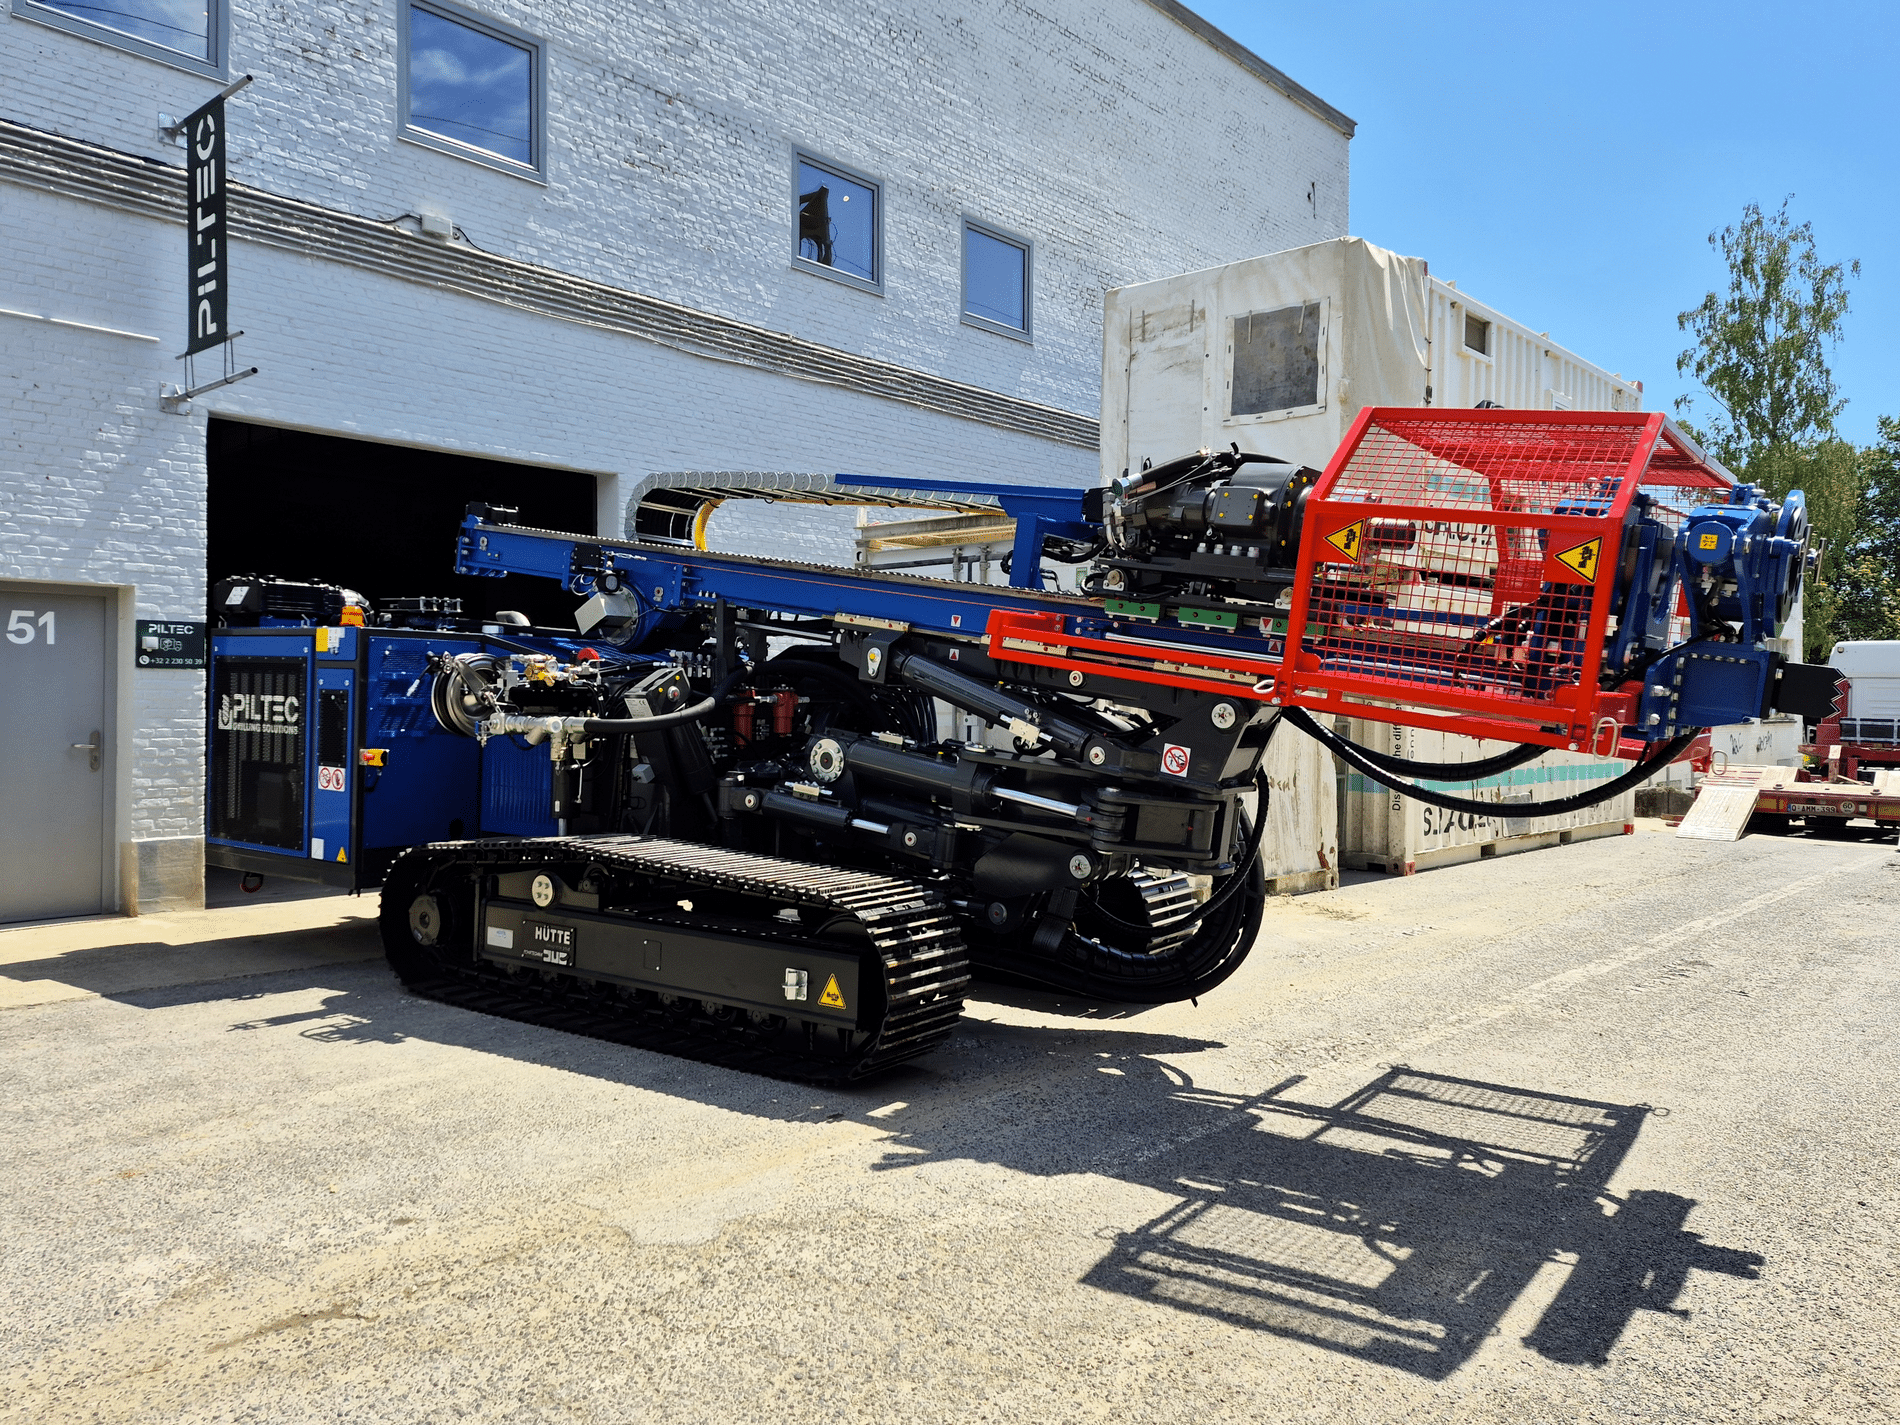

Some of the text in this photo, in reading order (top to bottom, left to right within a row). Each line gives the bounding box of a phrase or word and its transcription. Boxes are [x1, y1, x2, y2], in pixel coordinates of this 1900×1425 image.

[6, 609, 55, 645] 51
[148, 623, 194, 635] PILTEC
[233, 693, 300, 723] PILTEC
[262, 723, 299, 736] SOLUTIONS
[1842, 802, 1853, 810] 60
[535, 925, 571, 945] HÜTTE
